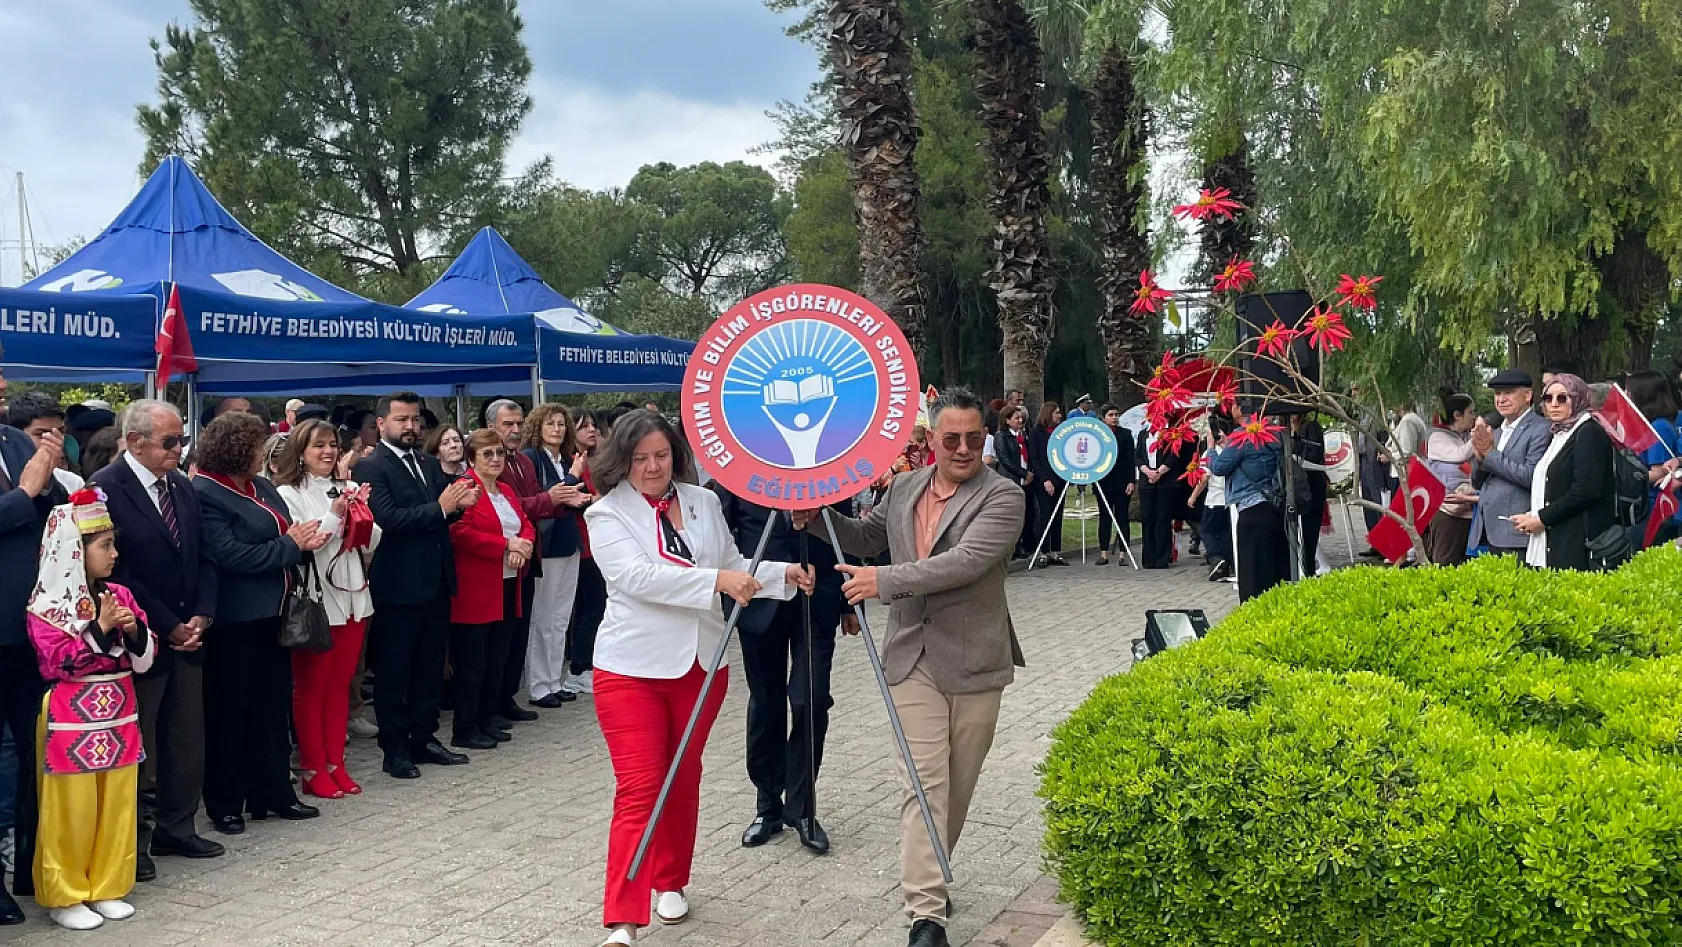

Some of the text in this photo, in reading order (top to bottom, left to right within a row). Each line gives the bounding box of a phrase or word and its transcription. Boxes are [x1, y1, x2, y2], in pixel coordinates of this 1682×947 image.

[1, 307, 121, 339] LERİ MÜD.
[201, 311, 518, 349] FETHİYE BELEDİYESİ KÜLTÜR İŞLERİ MÜD.
[559, 345, 692, 367] FETHİYE BELEDİYESİ KÜLTÜ
[781, 366, 814, 378] 2005
[693, 291, 911, 468] EĞİTİM VE BİLİM İŞGÖRENLERİ SENDİKASI
[746, 457, 875, 501] EĞİTİM-İŞ
